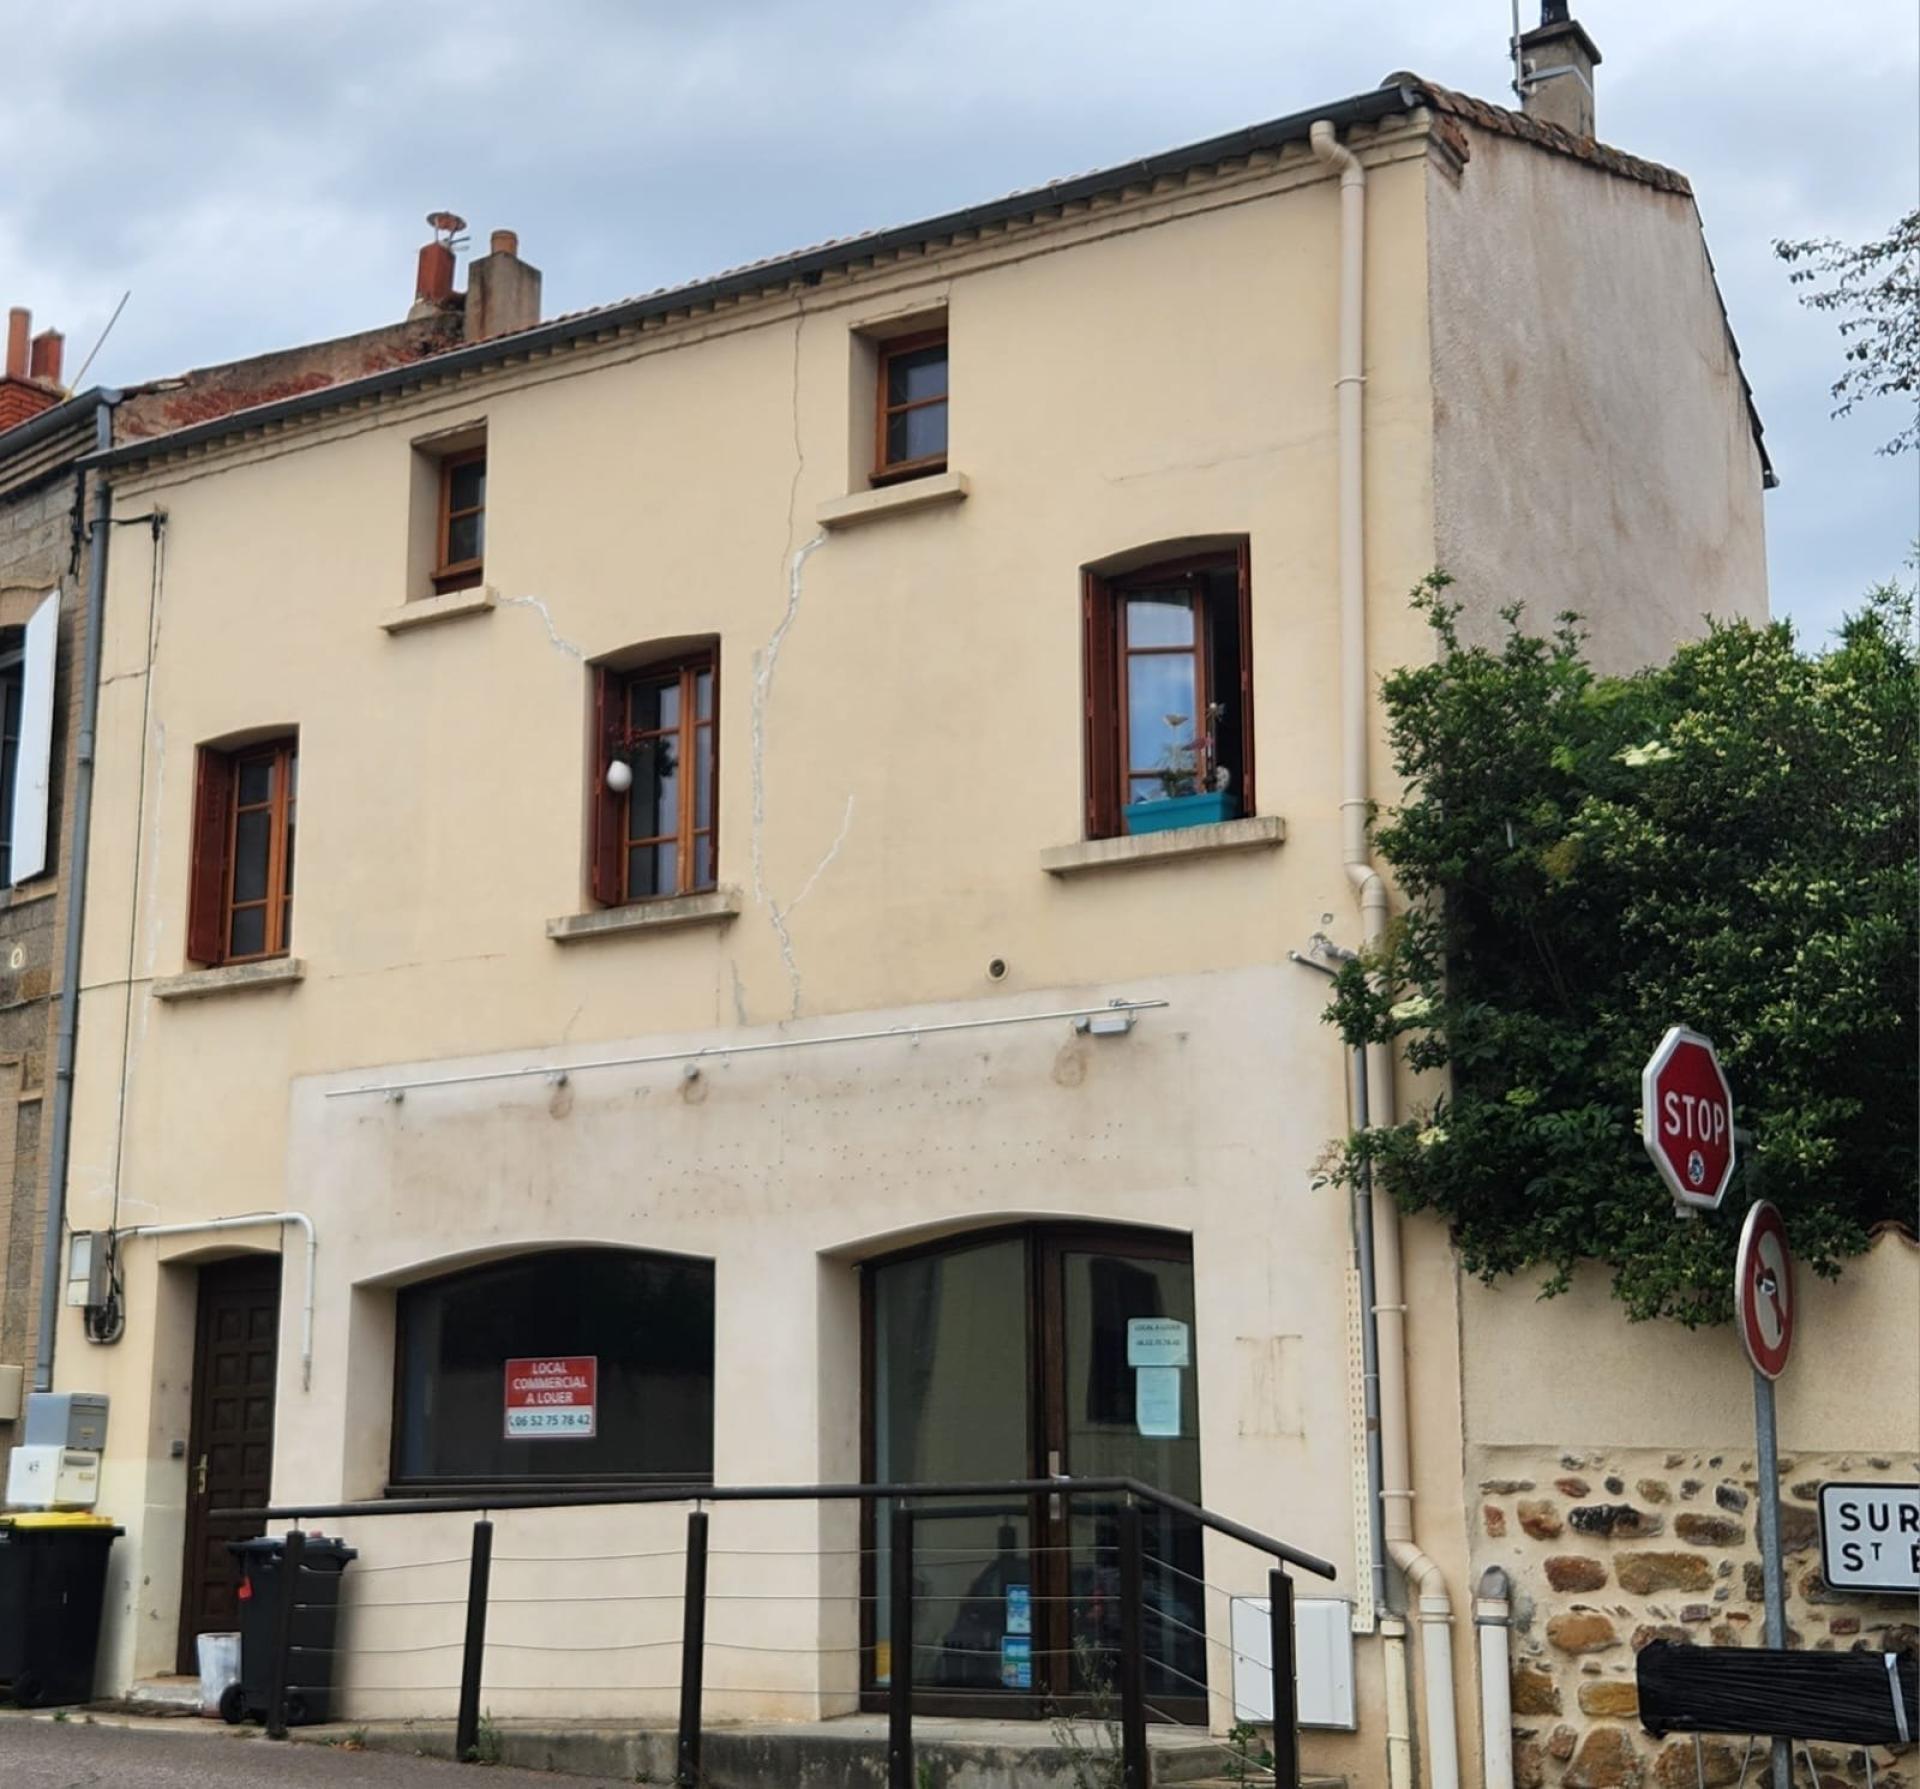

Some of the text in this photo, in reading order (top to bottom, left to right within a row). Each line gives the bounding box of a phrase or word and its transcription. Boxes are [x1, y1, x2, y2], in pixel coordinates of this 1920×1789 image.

[1664, 1090, 1725, 1146] STOP
[532, 1361, 568, 1375] LOCAL
[512, 1376, 588, 1390] COMMERCIAL
[525, 1391, 574, 1405] A LOUER
[515, 1415, 529, 1427] 06
[546, 1414, 559, 1426] 75
[577, 1413, 591, 1426] 42
[1839, 1502, 1920, 1532] SUR
